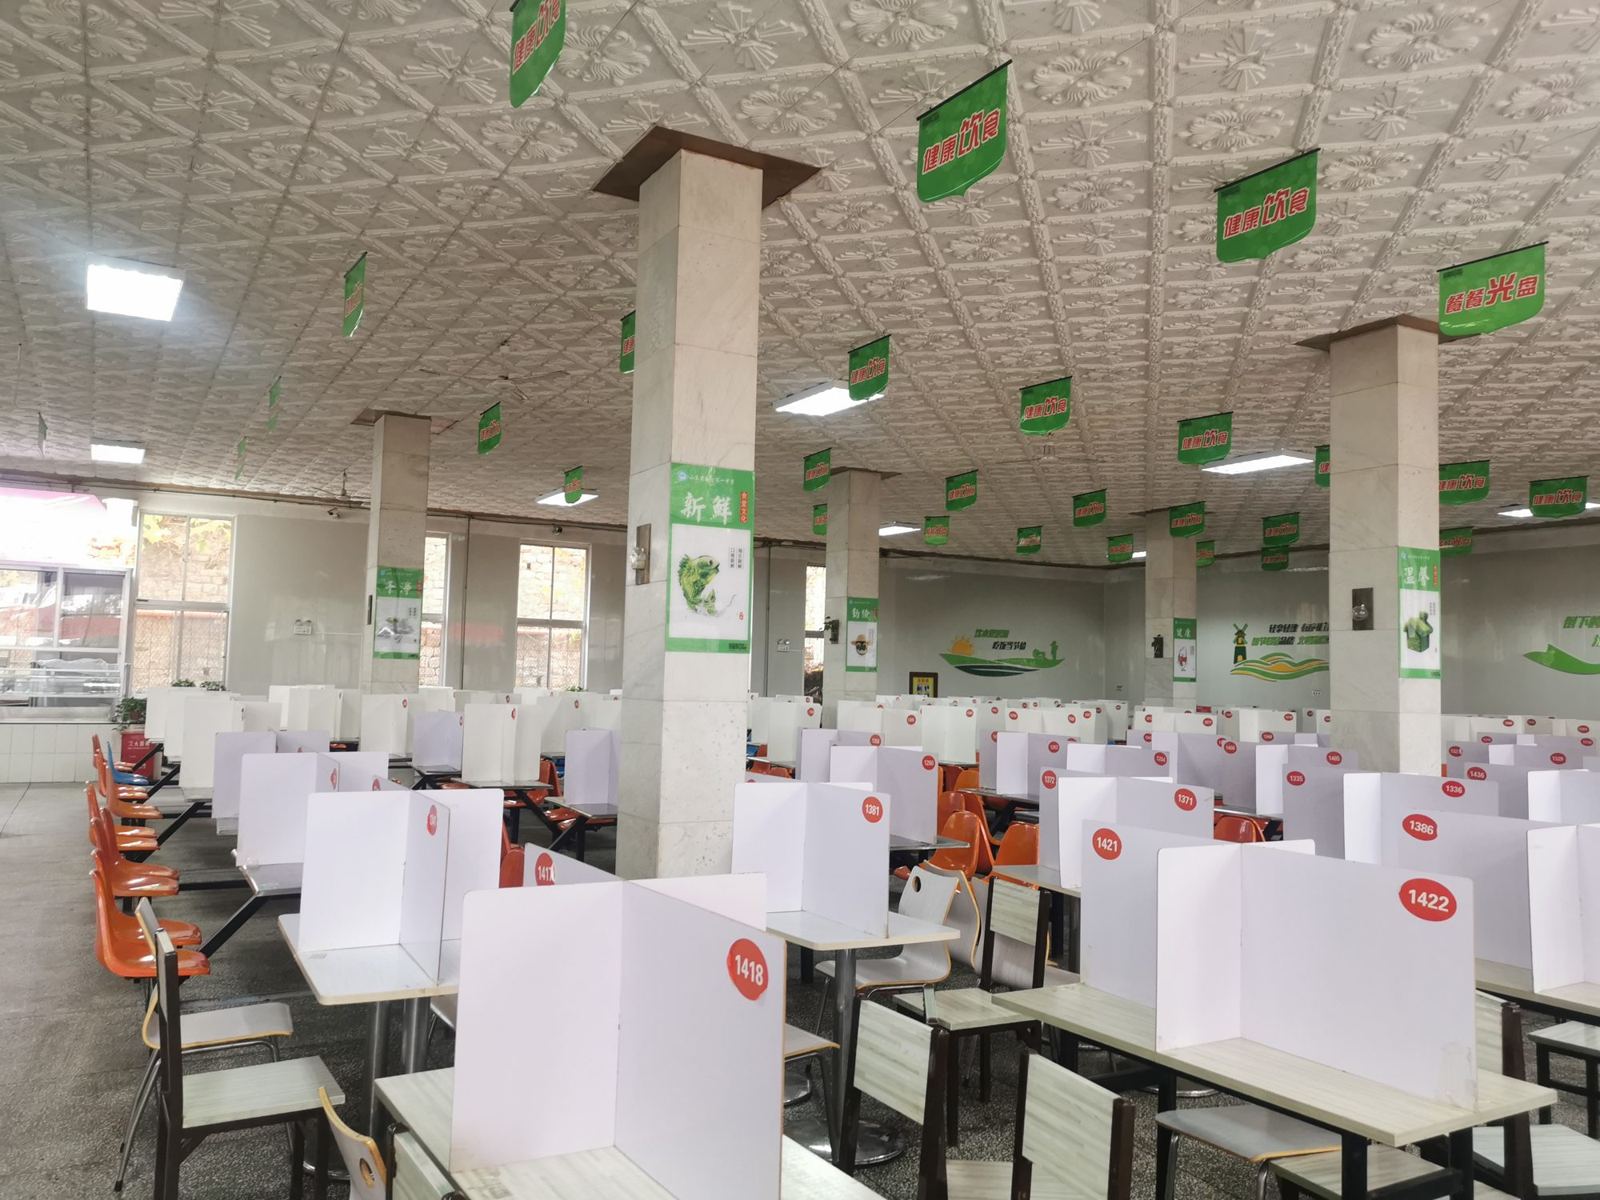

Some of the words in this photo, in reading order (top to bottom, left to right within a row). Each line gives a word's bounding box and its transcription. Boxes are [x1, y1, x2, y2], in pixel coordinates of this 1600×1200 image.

[922, 110, 1000, 174] 健康饮食
[1223, 187, 1309, 239] 健康饮食
[1446, 273, 1538, 314] 餐餐光盘
[680, 491, 733, 525] 新鲜
[865, 804, 880, 817] 1381
[1178, 794, 1194, 805] 1371
[1409, 815, 1435, 836] 1386
[1096, 836, 1118, 853] 1421
[1409, 889, 1450, 912] 1422
[735, 954, 764, 986] 1418
